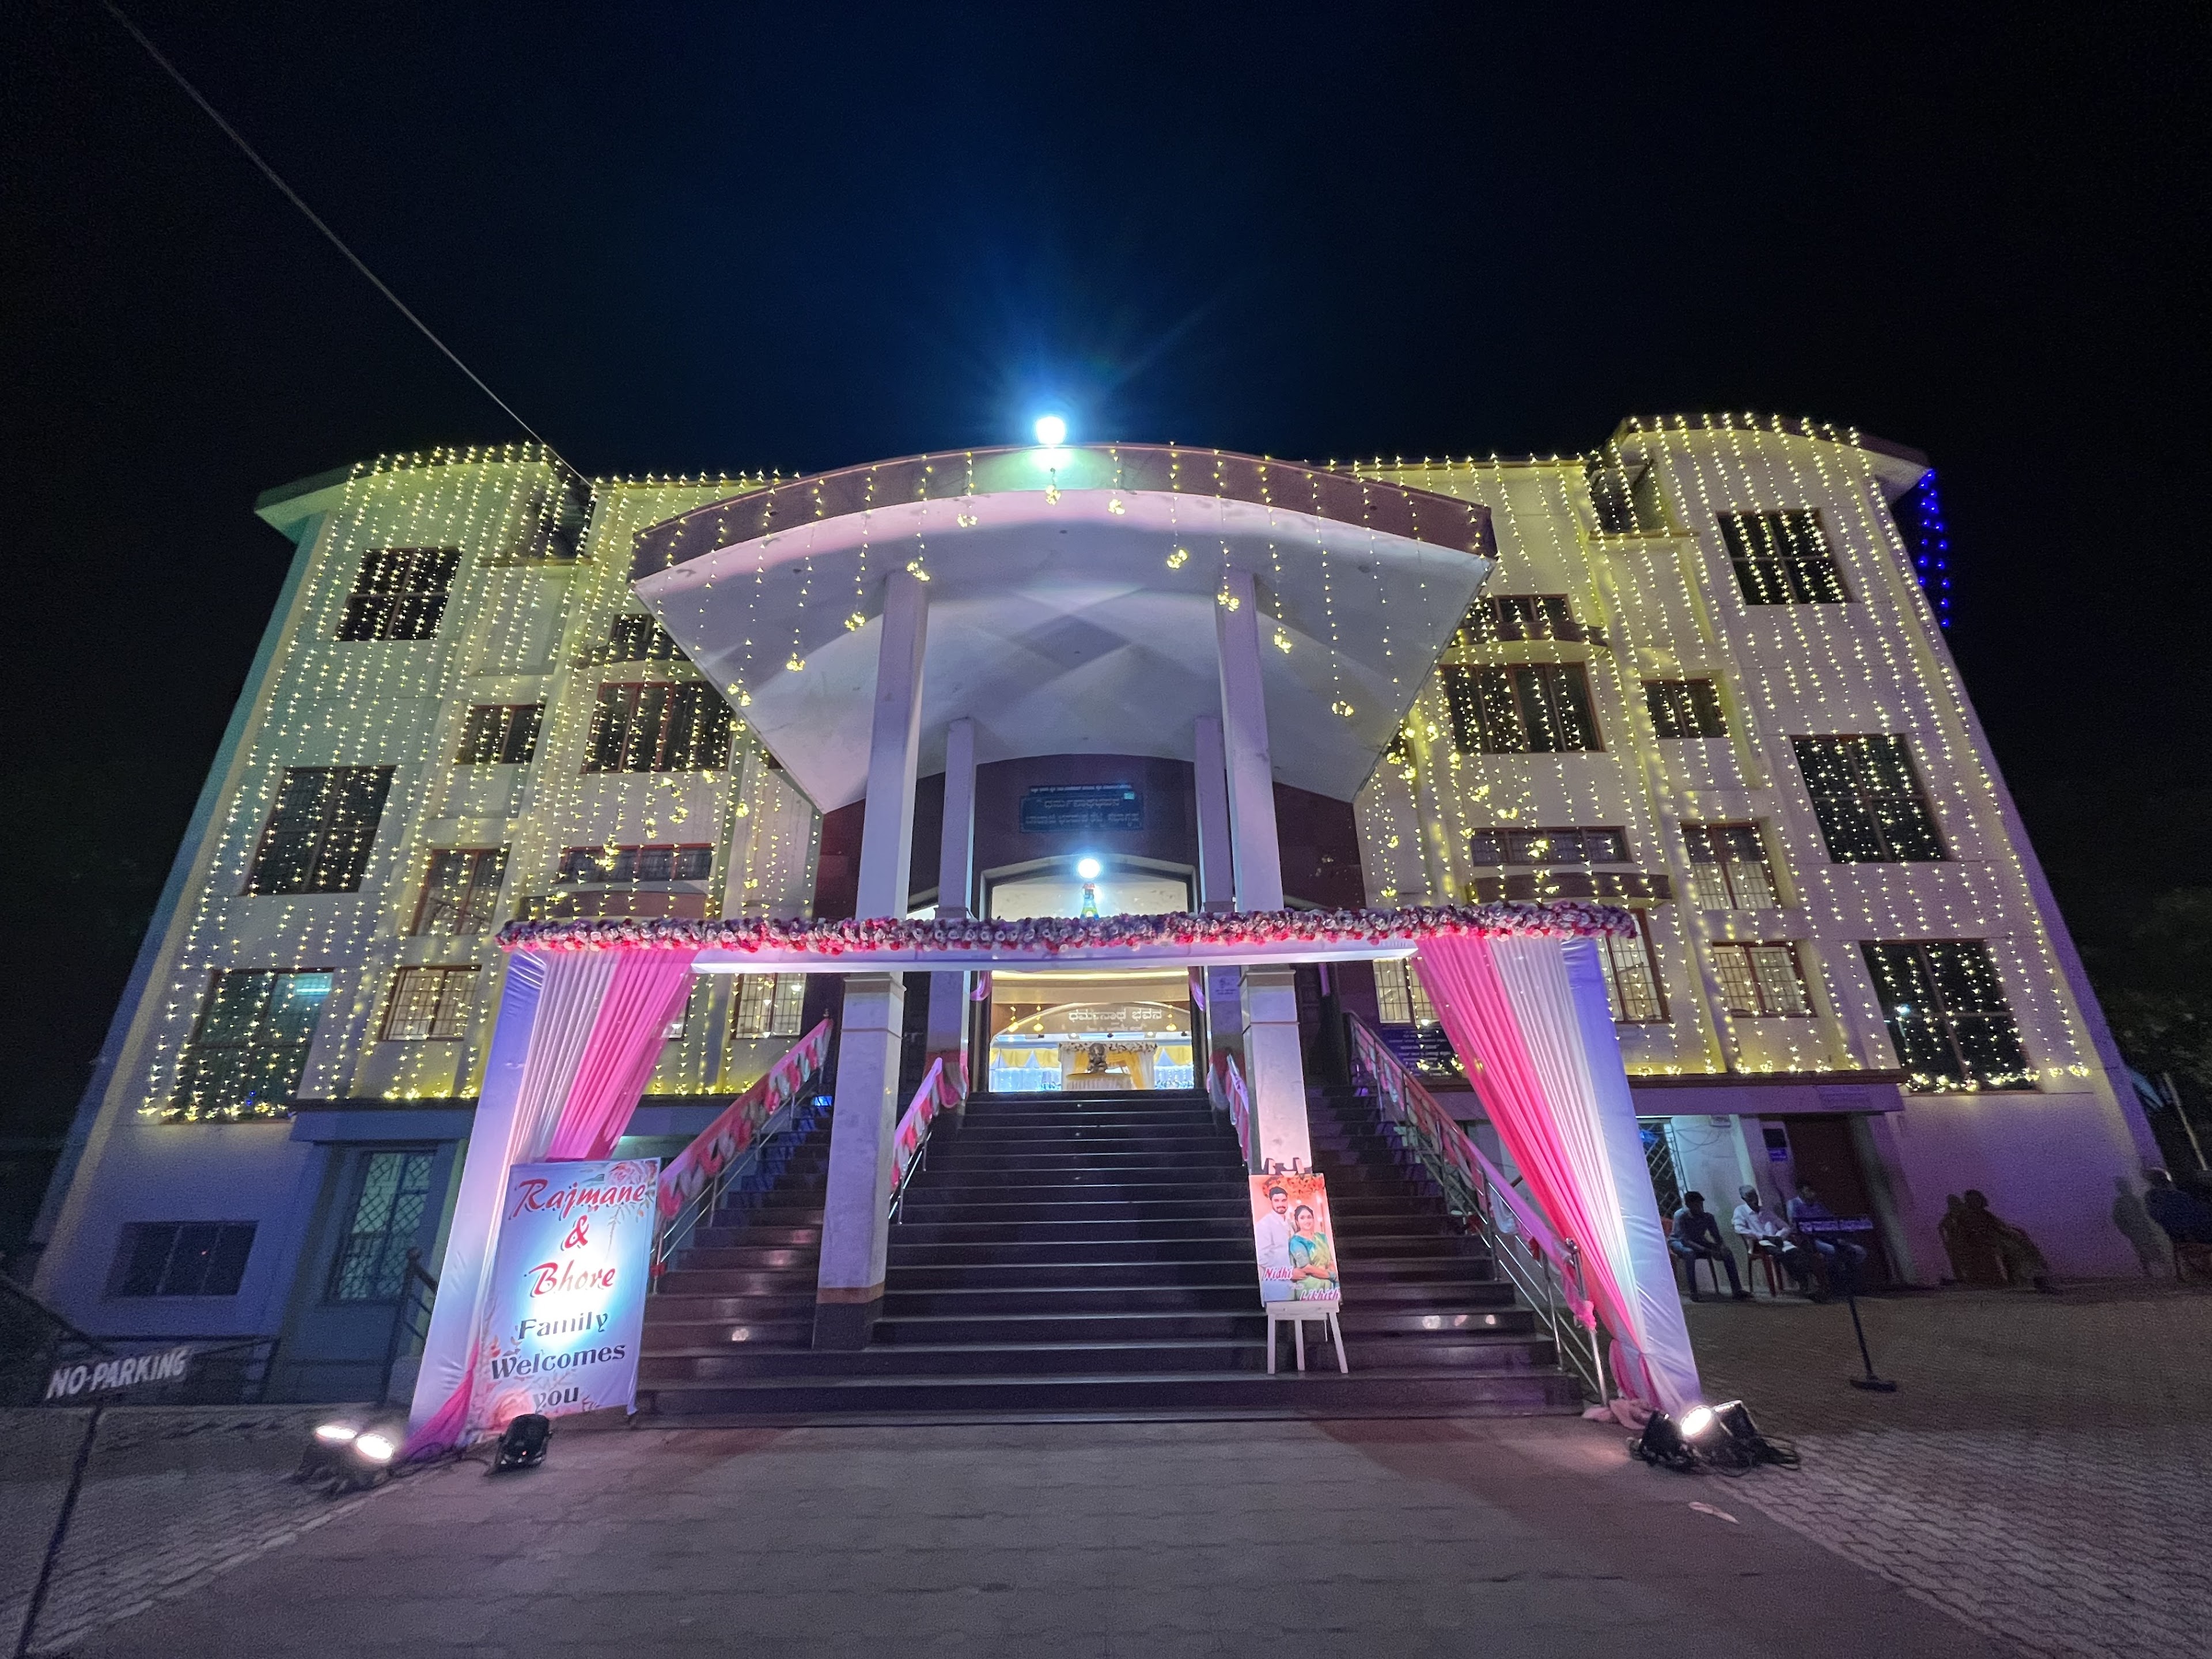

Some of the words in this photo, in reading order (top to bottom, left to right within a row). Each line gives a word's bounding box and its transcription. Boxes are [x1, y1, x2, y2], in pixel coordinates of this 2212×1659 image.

[1131, 1008, 1162, 1022] ಭವನ
[512, 1179, 646, 1218] Rajmane
[562, 1215, 589, 1250] &
[528, 1260, 616, 1296] Bhore
[1264, 1266, 1293, 1280] Nidhi
[518, 1311, 609, 1340] Family
[491, 1344, 626, 1380] Welcomes
[532, 1386, 579, 1411] you
